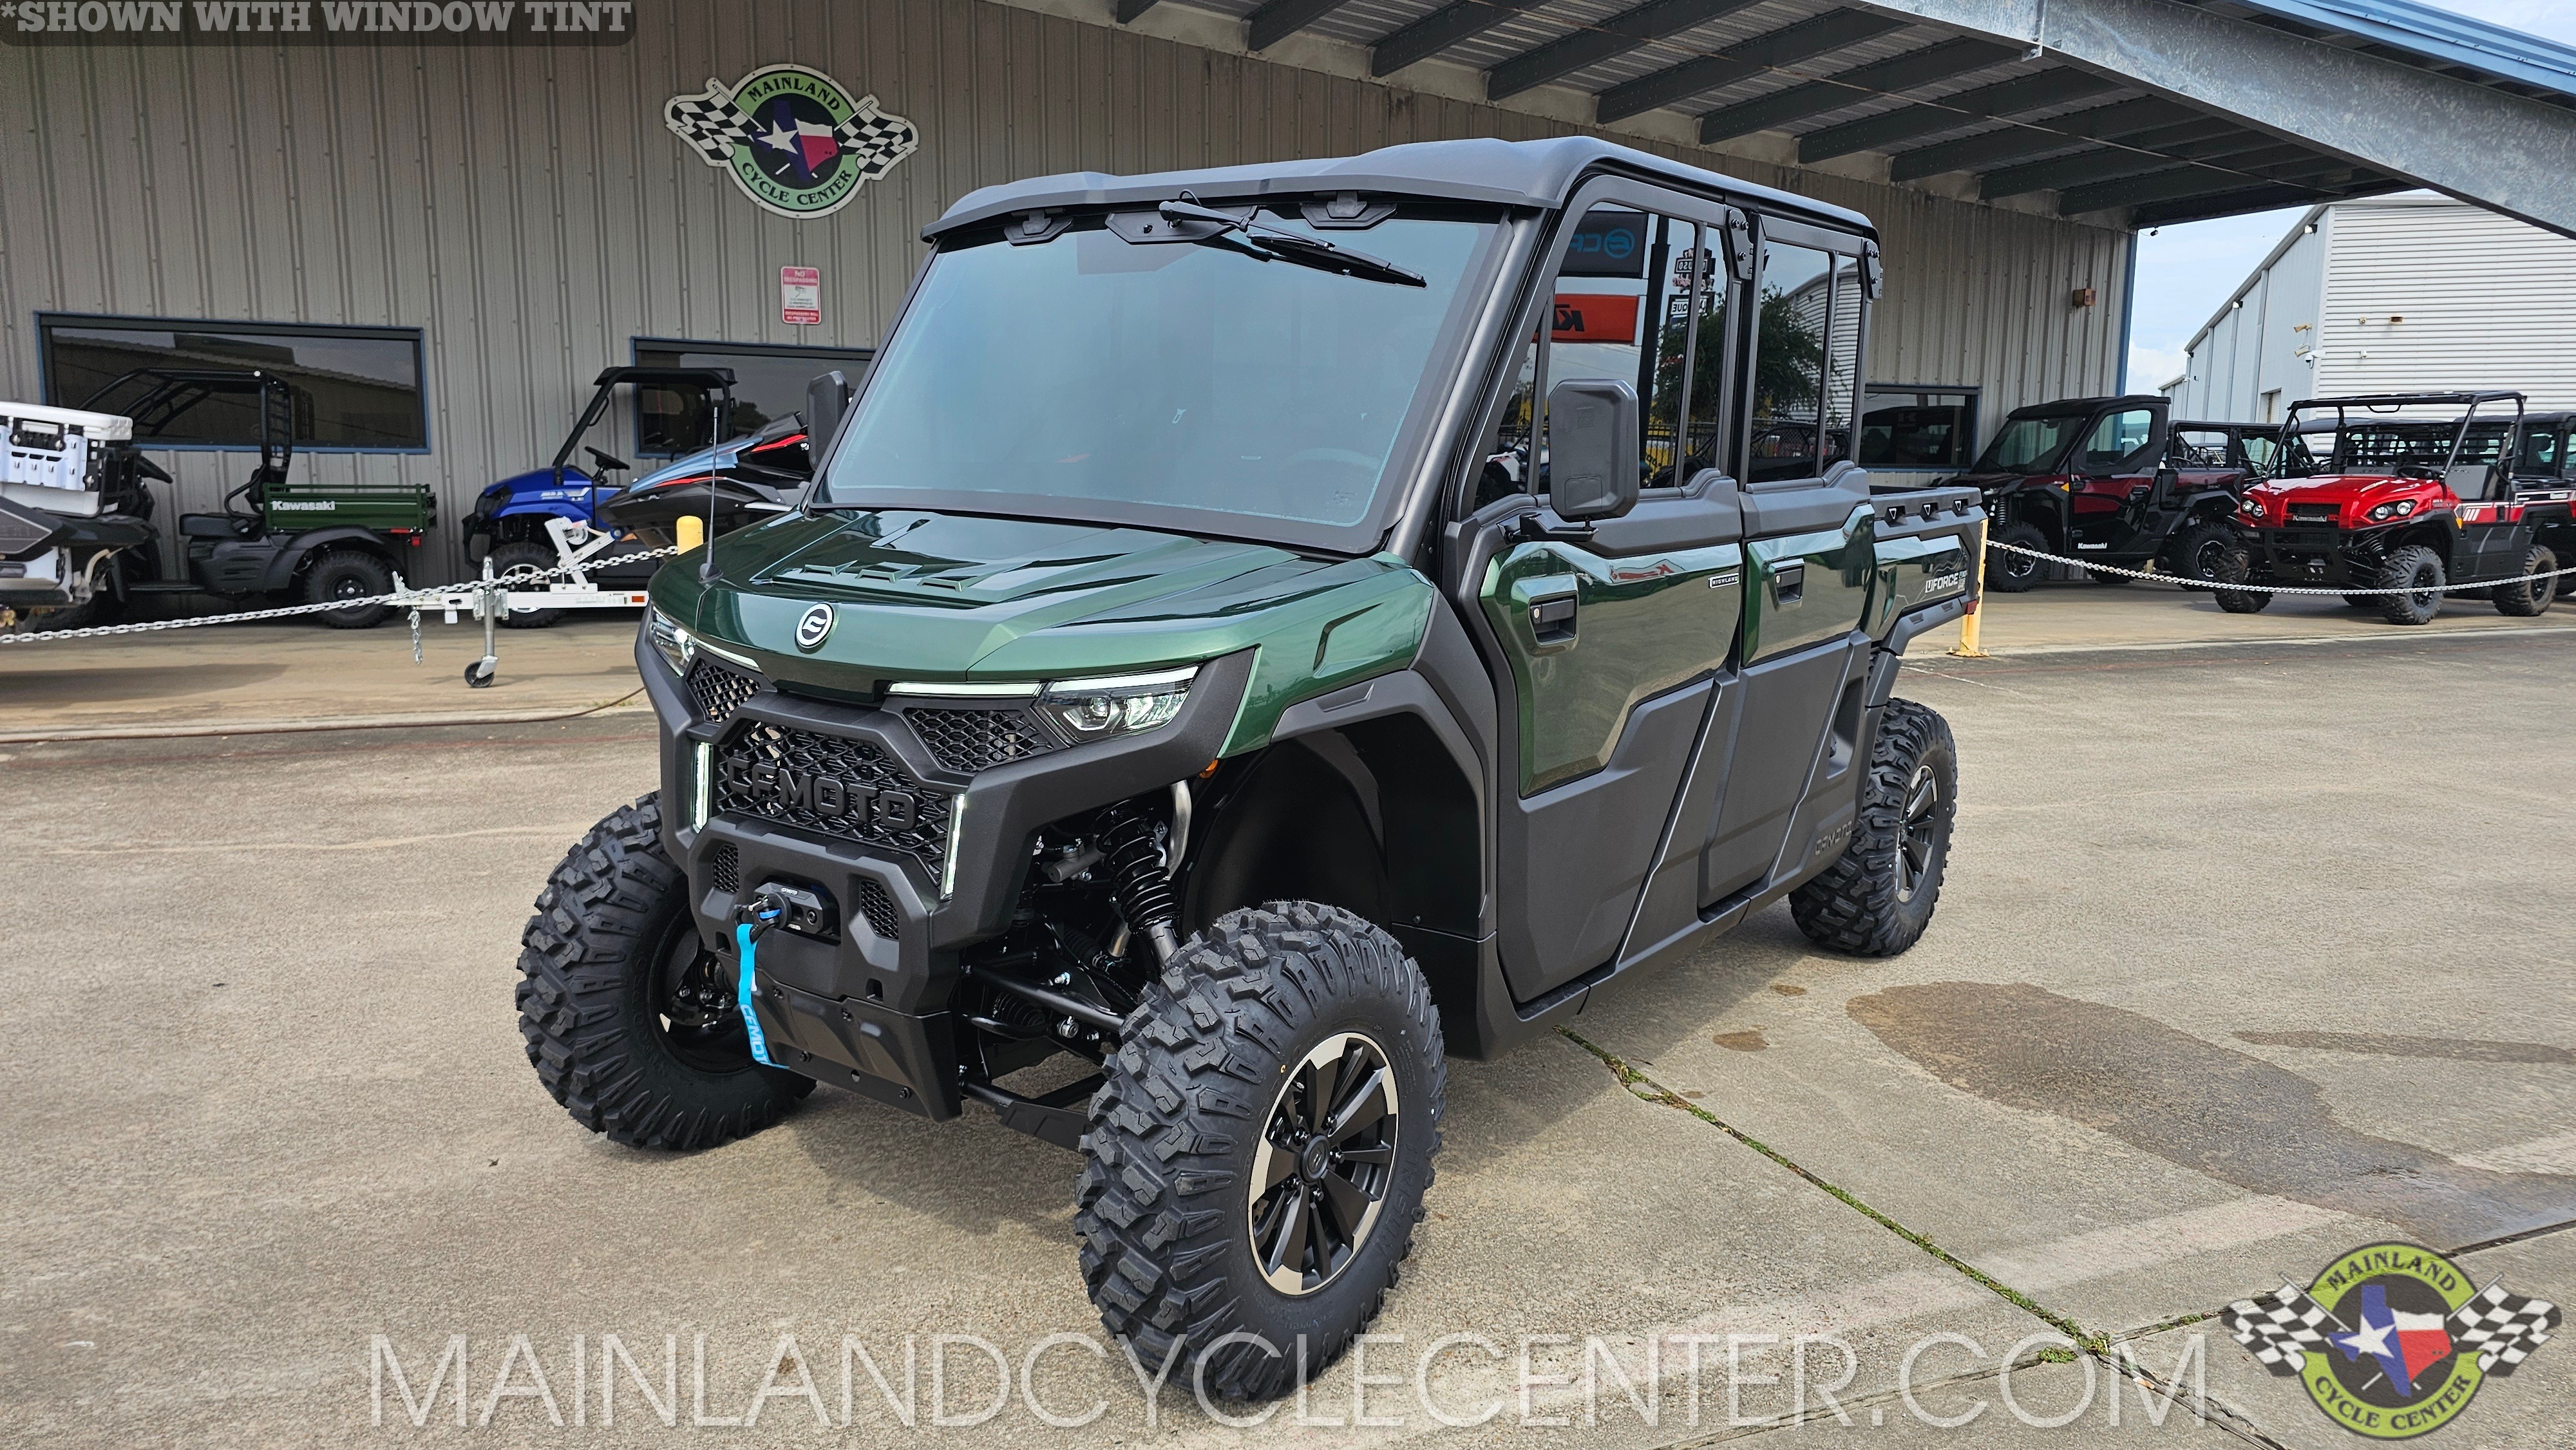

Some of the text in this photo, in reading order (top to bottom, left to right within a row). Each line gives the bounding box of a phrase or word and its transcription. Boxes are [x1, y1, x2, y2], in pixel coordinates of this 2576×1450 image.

[747, 77, 840, 111] MAINLAND
[743, 162, 852, 205] CYCLE CENTER
[272, 501, 335, 511] Kawasaki
[1925, 572, 1959, 593] UFORCE
[727, 757, 915, 830] CFMOTO
[1815, 820, 1852, 856] CFMOTO
[740, 1004, 770, 1064] CFMOT
